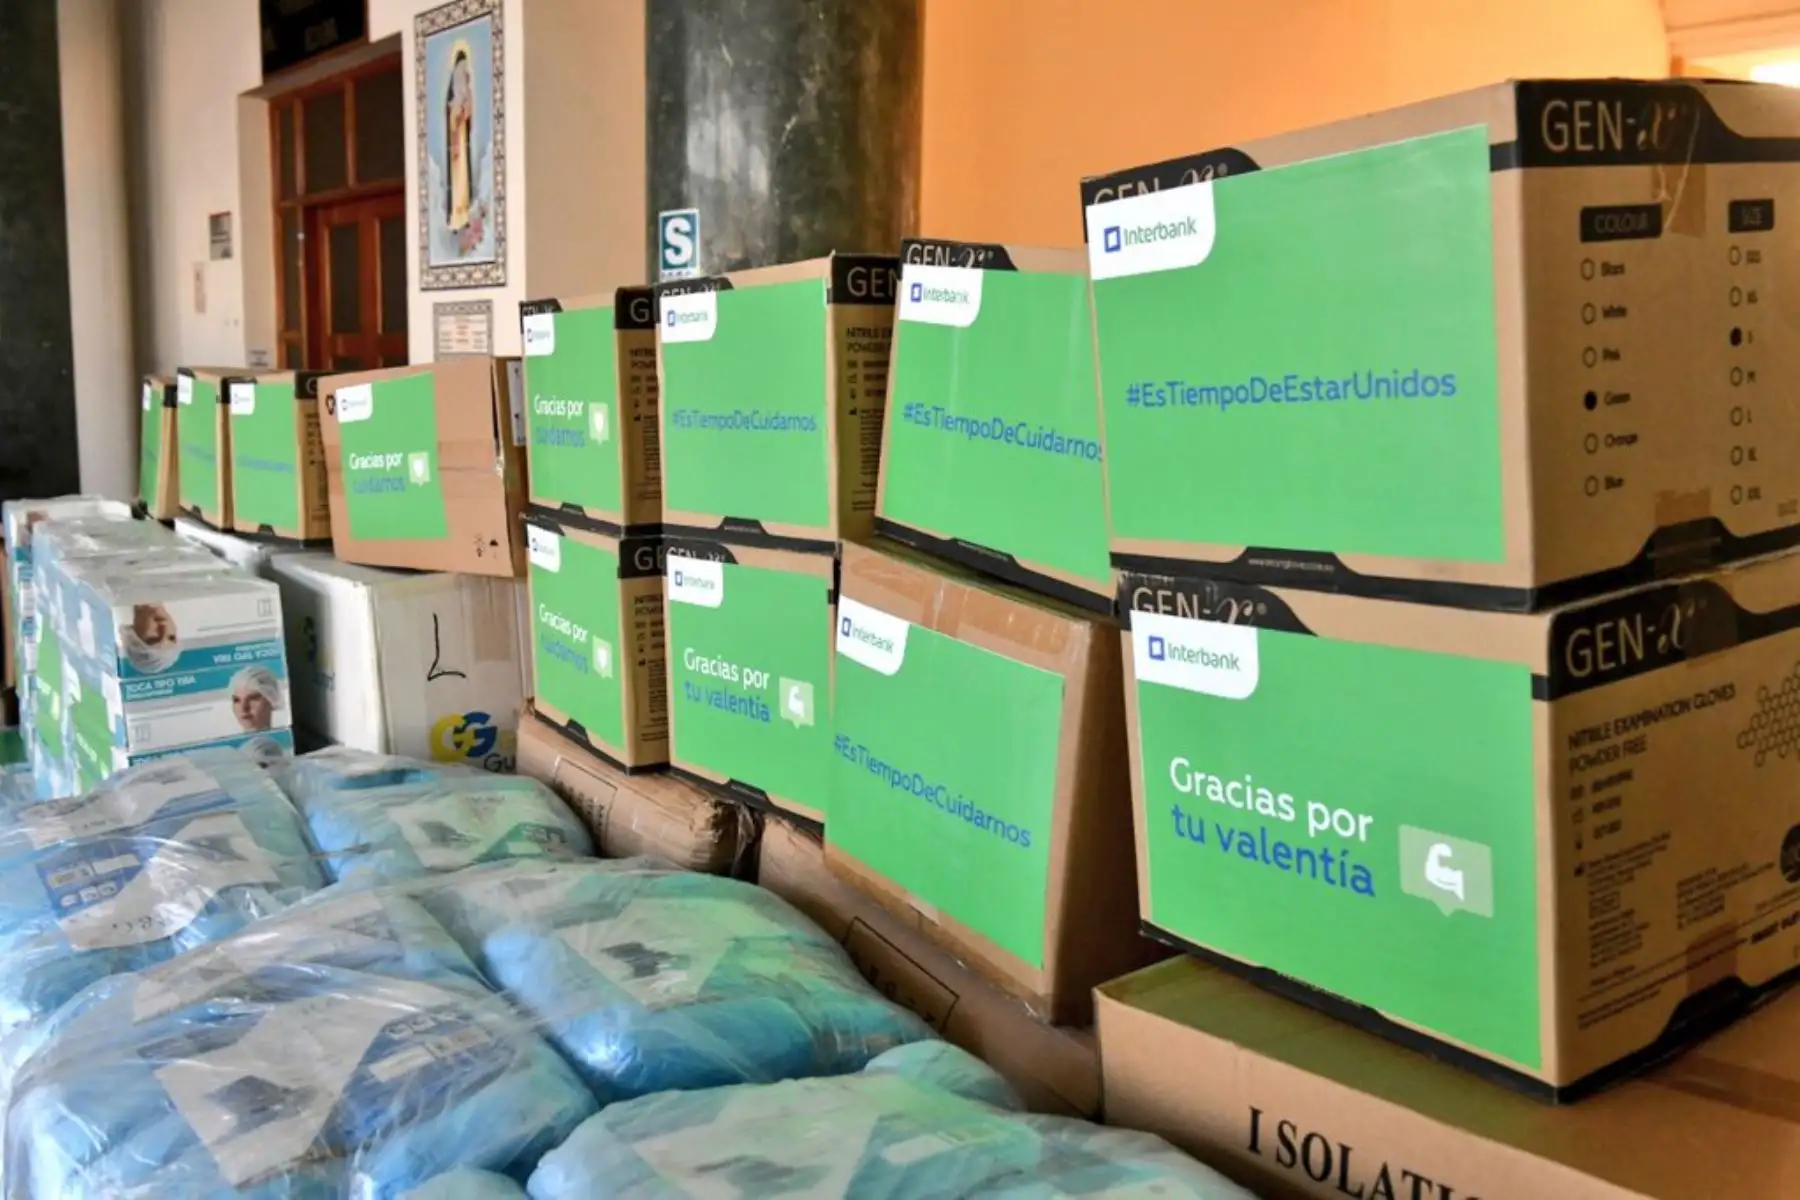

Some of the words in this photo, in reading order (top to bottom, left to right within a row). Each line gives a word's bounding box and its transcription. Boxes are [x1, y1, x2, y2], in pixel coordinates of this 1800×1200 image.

[664, 217, 693, 265] S
[1123, 216, 1198, 246] Interbank
[923, 286, 972, 304] Interbank
[1126, 370, 1457, 411] #EsTiempoDeEstarUnidos
[534, 395, 566, 416] Gracias
[567, 400, 584, 421] por
[672, 408, 817, 433] #EsTiempoDeCuidarnos
[350, 453, 384, 471] Gracias
[386, 452, 403, 472] por
[539, 603, 573, 636] Gracias
[572, 621, 588, 643] por
[851, 623, 895, 655] Interbank
[684, 648, 739, 681] Gracias
[743, 666, 770, 690] por
[1167, 642, 1240, 671] Interbank
[684, 680, 700, 701] tu
[834, 731, 1032, 848] #EsTiempoDeCuidarnos
[1169, 756, 1295, 821] Gracias
[1307, 800, 1374, 842] por
[1171, 803, 1205, 844] tu
[1215, 822, 1377, 898] valentía
